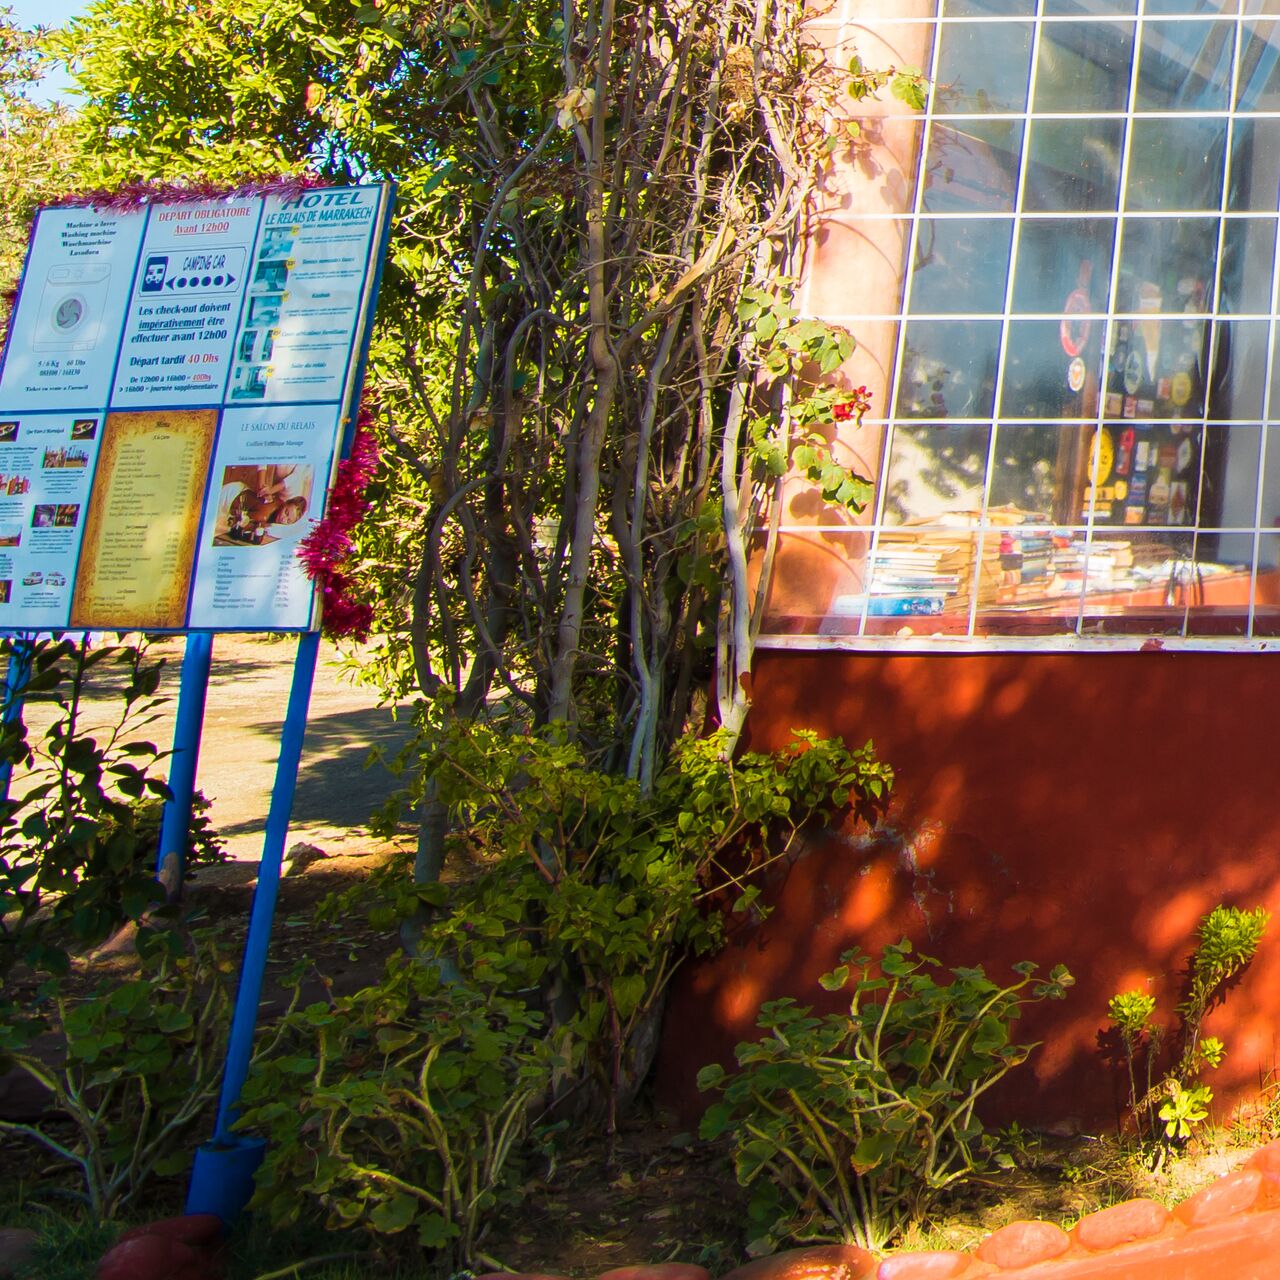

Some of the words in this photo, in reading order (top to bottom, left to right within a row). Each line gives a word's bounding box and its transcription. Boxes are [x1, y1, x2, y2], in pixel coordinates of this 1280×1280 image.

[281, 192, 363, 210] HOTEL
[194, 207, 252, 217] OBLIGATOIRE
[265, 213, 277, 225] LE
[277, 211, 306, 224] RELAIS
[307, 210, 318, 222] DE
[318, 206, 374, 221] MARRAKECH
[174, 224, 198, 234] Avant
[201, 222, 230, 233] 12h00
[182, 254, 213, 272] CAMPING
[212, 254, 226, 270] CAR
[138, 306, 153, 316] Les
[155, 304, 198, 315] check-out
[199, 302, 231, 313] doivent
[138, 317, 206, 330] impérativement
[207, 316, 225, 326] être
[131, 333, 170, 344] effectuer
[171, 331, 196, 341] avant
[198, 329, 228, 340] 12h00
[129, 356, 160, 368] Départ
[161, 354, 187, 365] tardif
[187, 353, 200, 364] 40
[202, 353, 219, 363] Dhs
[240, 423, 250, 432] LE
[251, 422, 276, 431] SALON
[276, 422, 289, 431] DU
[290, 421, 316, 430] RELAIS
